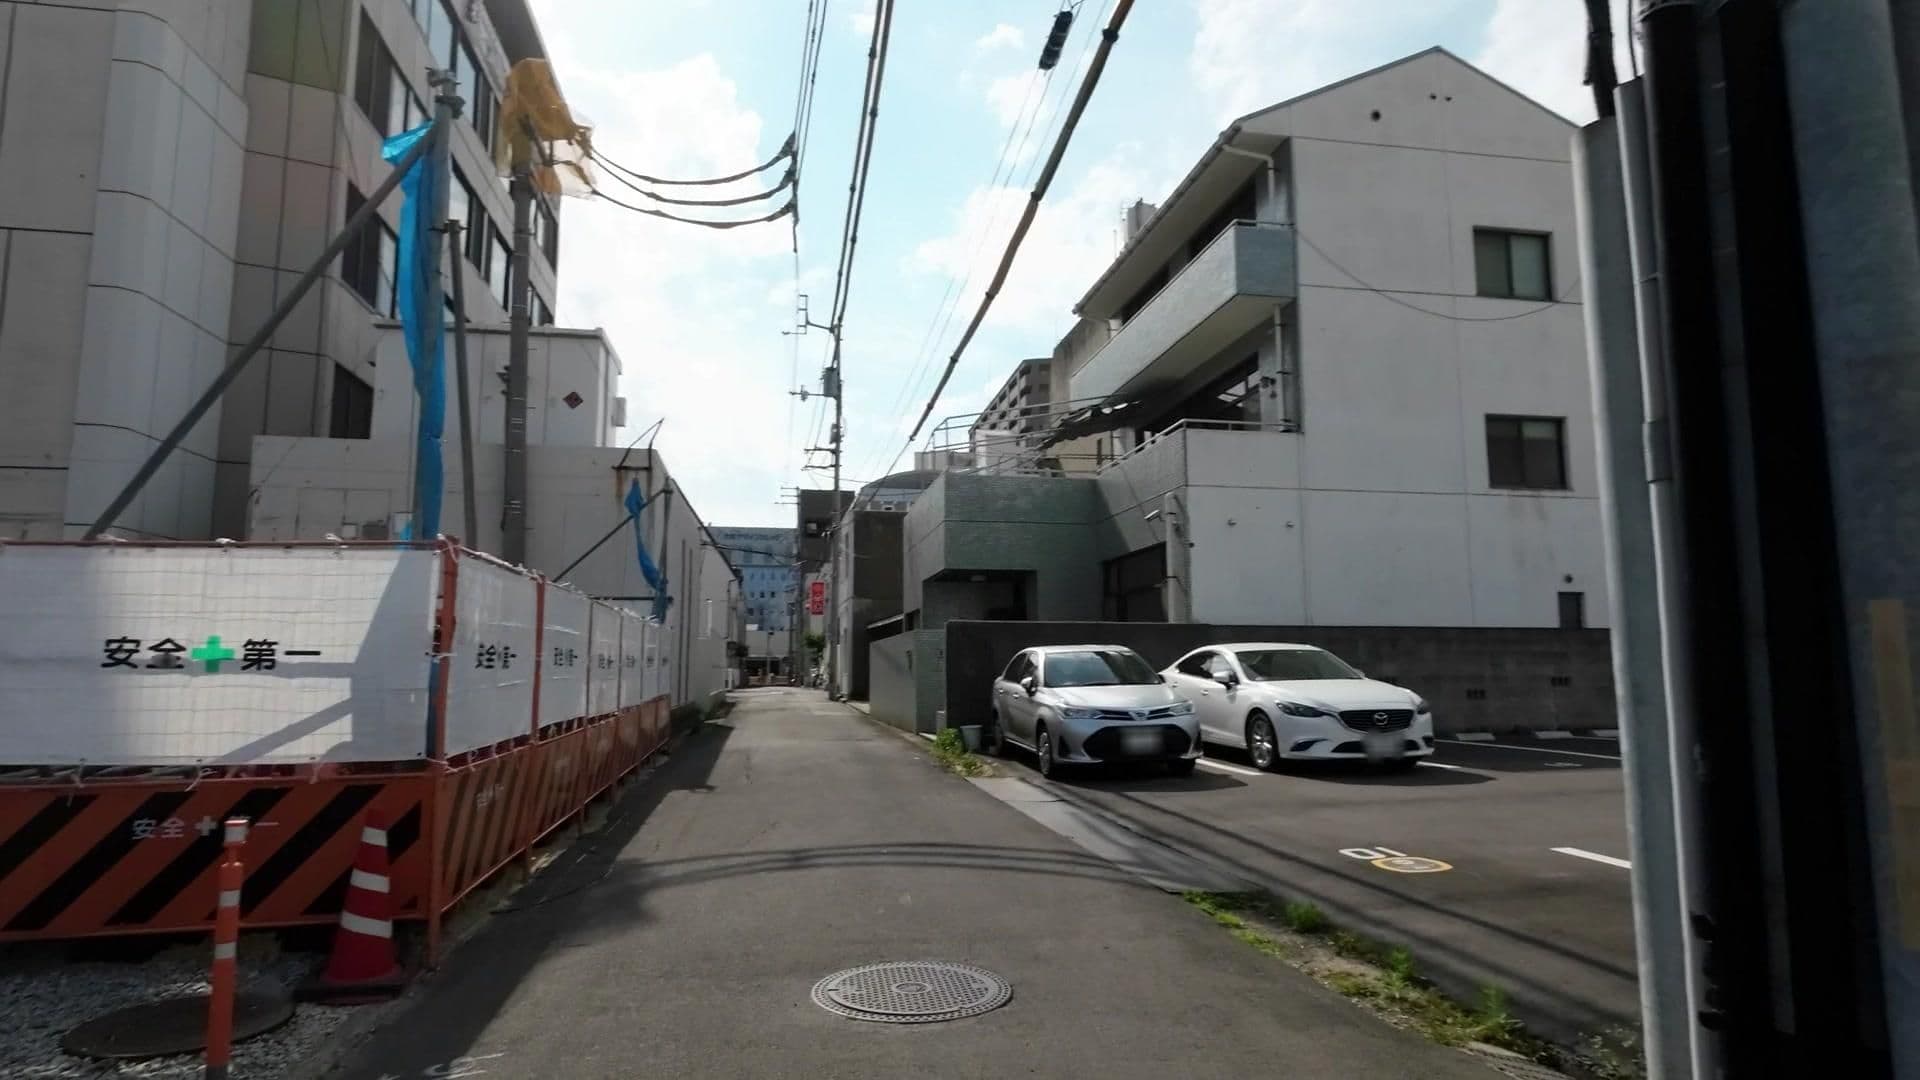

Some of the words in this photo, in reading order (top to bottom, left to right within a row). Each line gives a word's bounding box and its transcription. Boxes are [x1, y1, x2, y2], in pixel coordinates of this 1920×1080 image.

[101, 636, 187, 670] 安全
[241, 638, 321, 671] 第一
[1337, 845, 1409, 860] 01
